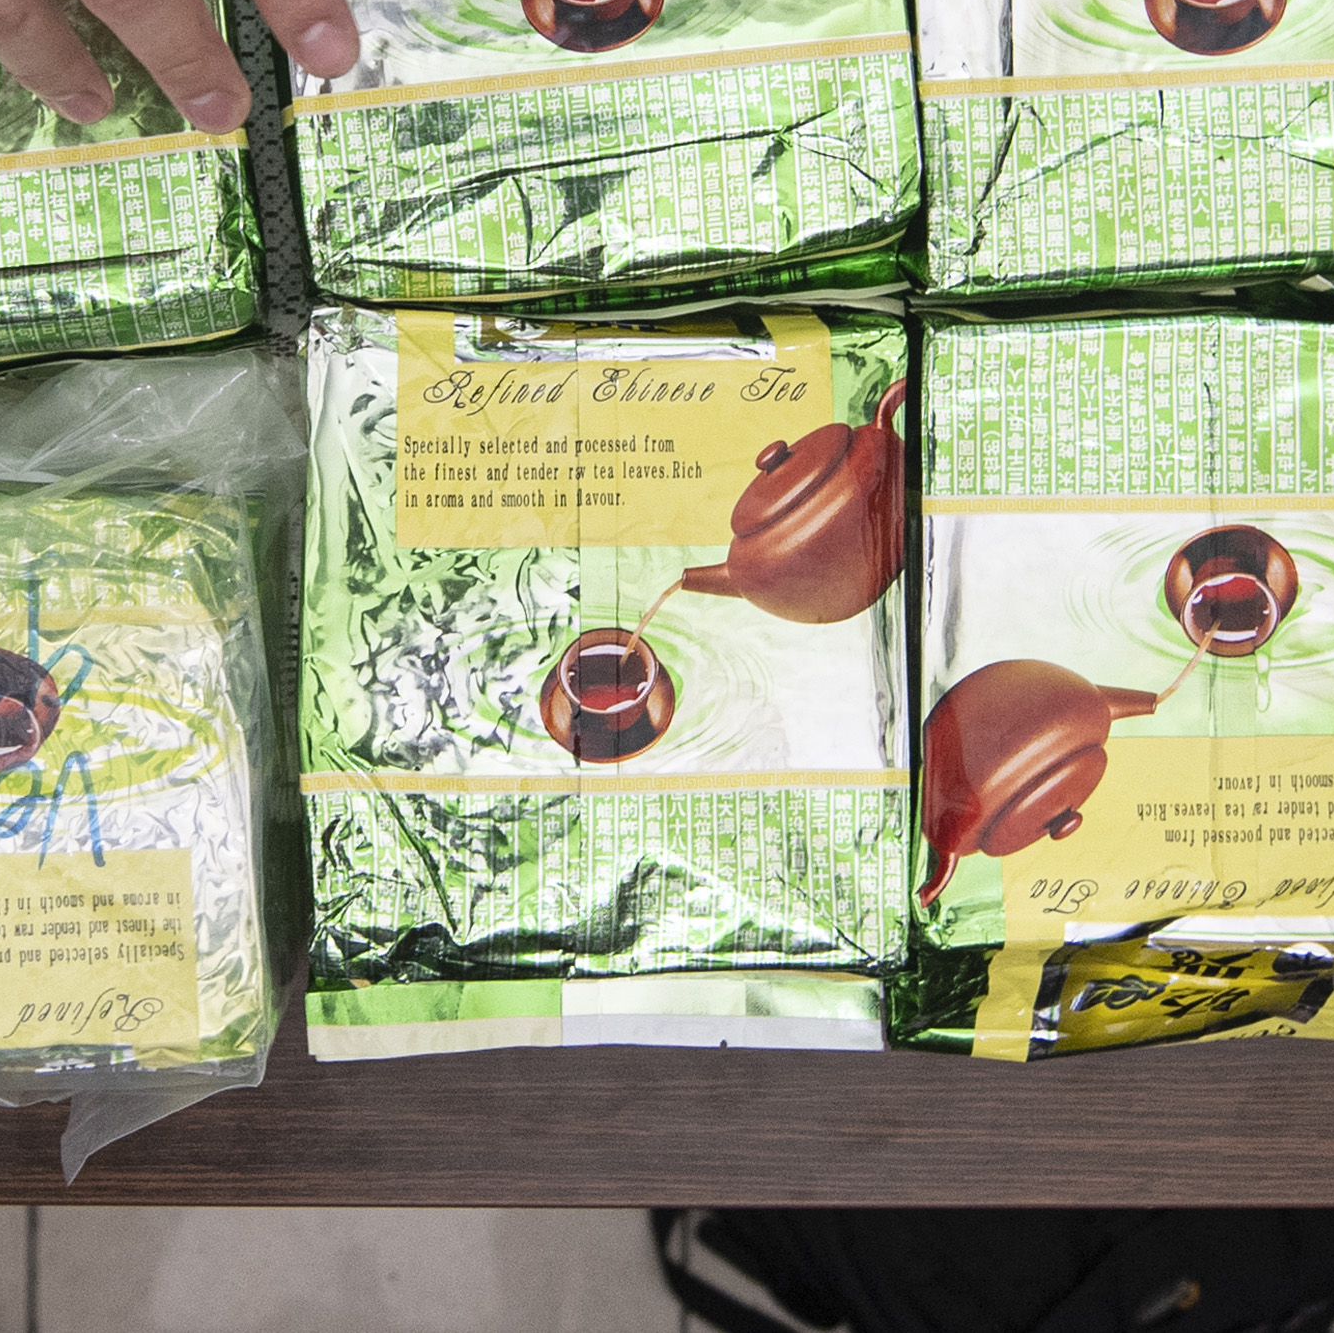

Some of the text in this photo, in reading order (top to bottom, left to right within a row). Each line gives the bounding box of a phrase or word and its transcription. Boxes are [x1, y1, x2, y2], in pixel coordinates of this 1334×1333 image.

[423, 369, 578, 416] Refined
[741, 367, 809, 401] Tea
[404, 434, 674, 458] Specially selected and from
[404, 462, 425, 480] the
[434, 462, 477, 481] finest
[486, 462, 509, 481] and
[516, 462, 558, 480] tender
[593, 463, 614, 479] tea
[425, 493, 464, 507] aroma
[470, 489, 492, 507] and
[500, 488, 544, 507] smooth
[1290, 774, 1333, 792] smooth
[1224, 803, 1245, 818] tea
[1277, 800, 1319, 819] tender
[1164, 829, 1194, 847] from
[1269, 827, 1290, 846] and
[39, 893, 84, 914] smooth
[91, 894, 114, 912] and
[122, 892, 159, 905] aroma
[1030, 879, 1099, 914] Tea
[13, 923, 34, 936] raw
[40, 920, 81, 940] tender
[88, 919, 108, 938] and
[115, 918, 155, 937] finest
[162, 918, 181, 935] the
[18, 948, 41, 967] and
[49, 946, 108, 967] selected
[117, 940, 184, 963] Specially
[4, 988, 163, 1039] Refined
